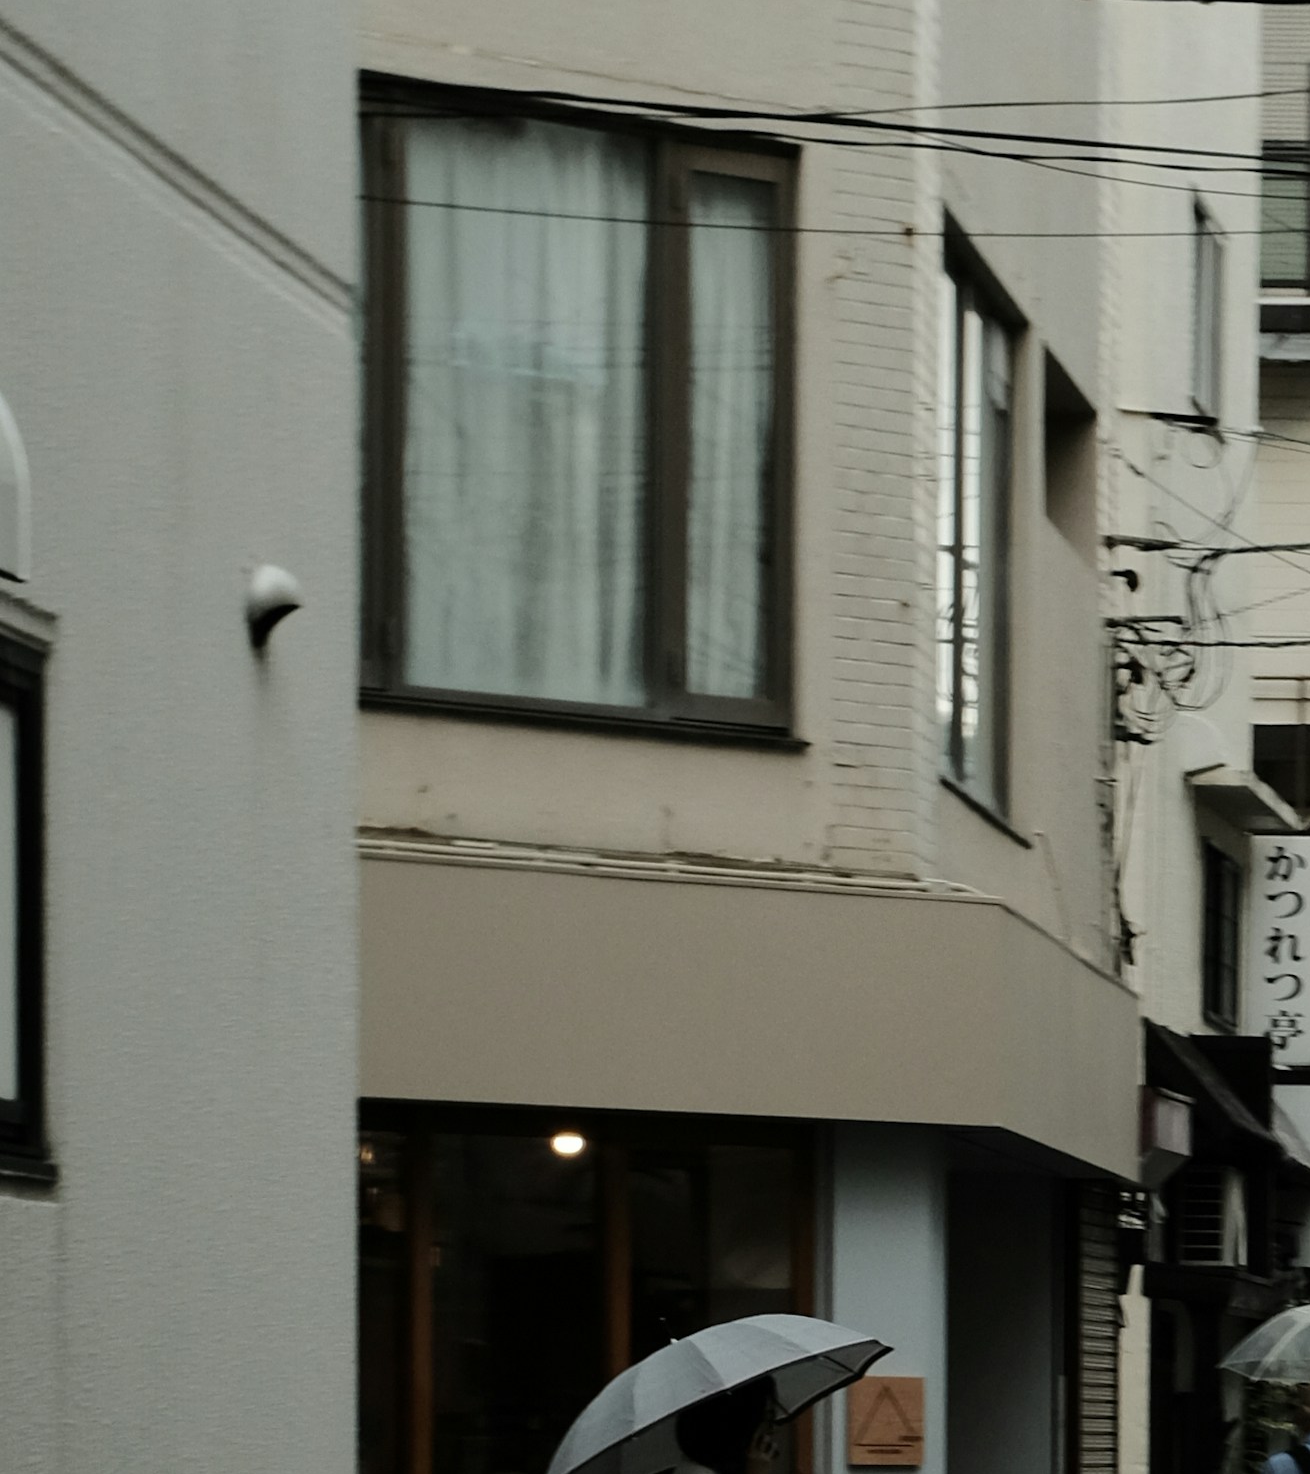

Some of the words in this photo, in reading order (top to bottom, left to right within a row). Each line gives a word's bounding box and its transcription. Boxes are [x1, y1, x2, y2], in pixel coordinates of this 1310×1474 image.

[1263, 845, 1309, 1050] かつれつ亭
